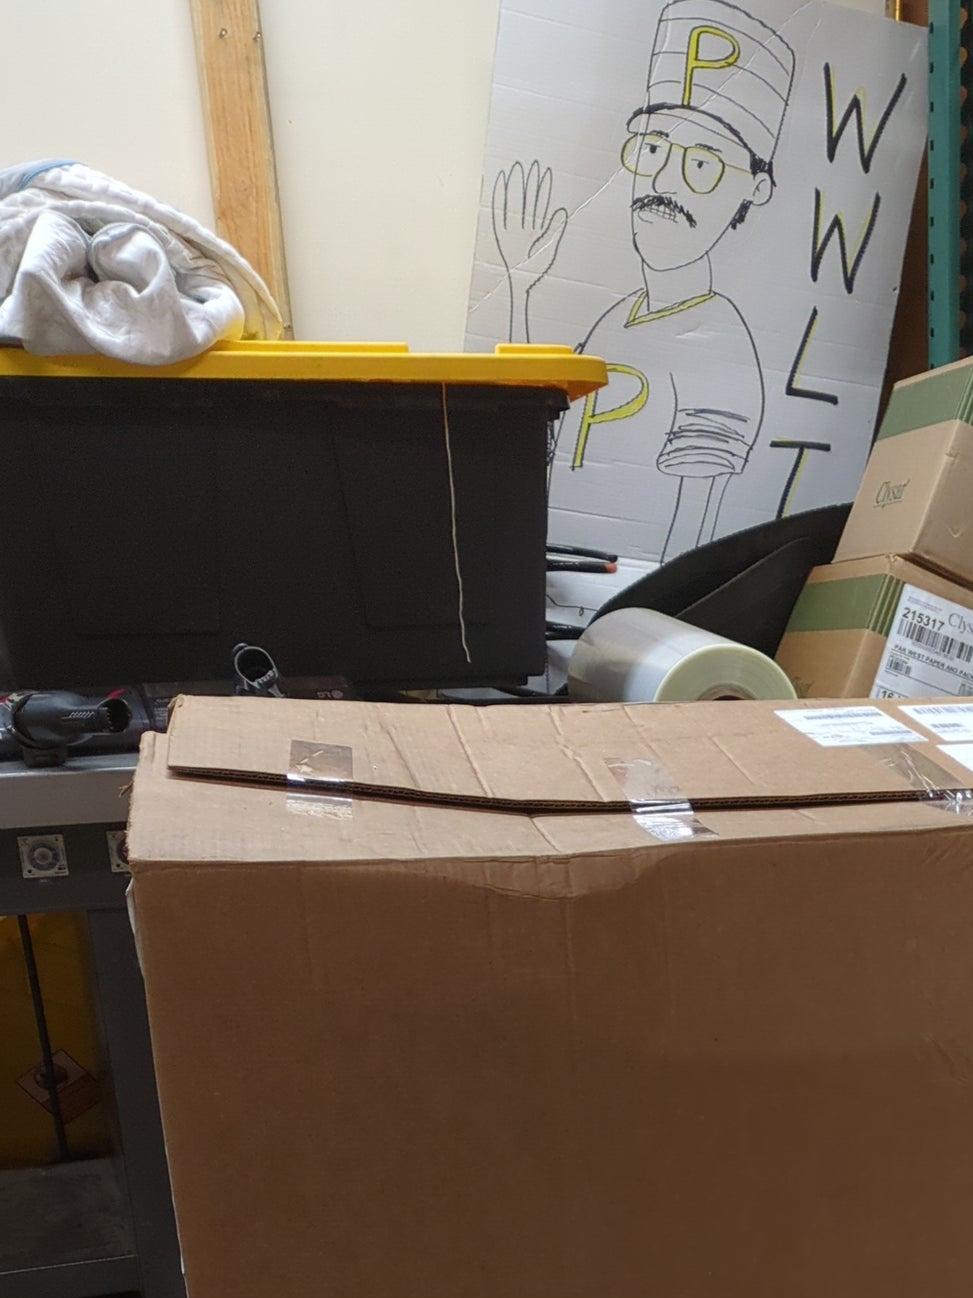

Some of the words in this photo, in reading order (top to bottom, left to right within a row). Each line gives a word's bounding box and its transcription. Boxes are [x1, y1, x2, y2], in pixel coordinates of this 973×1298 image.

[681, 25, 740, 107] P
[902, 607, 945, 632] 215317
[894, 644, 907, 654] PAK
[908, 647, 925, 660] WEST
[925, 655, 945, 669] PAPER
